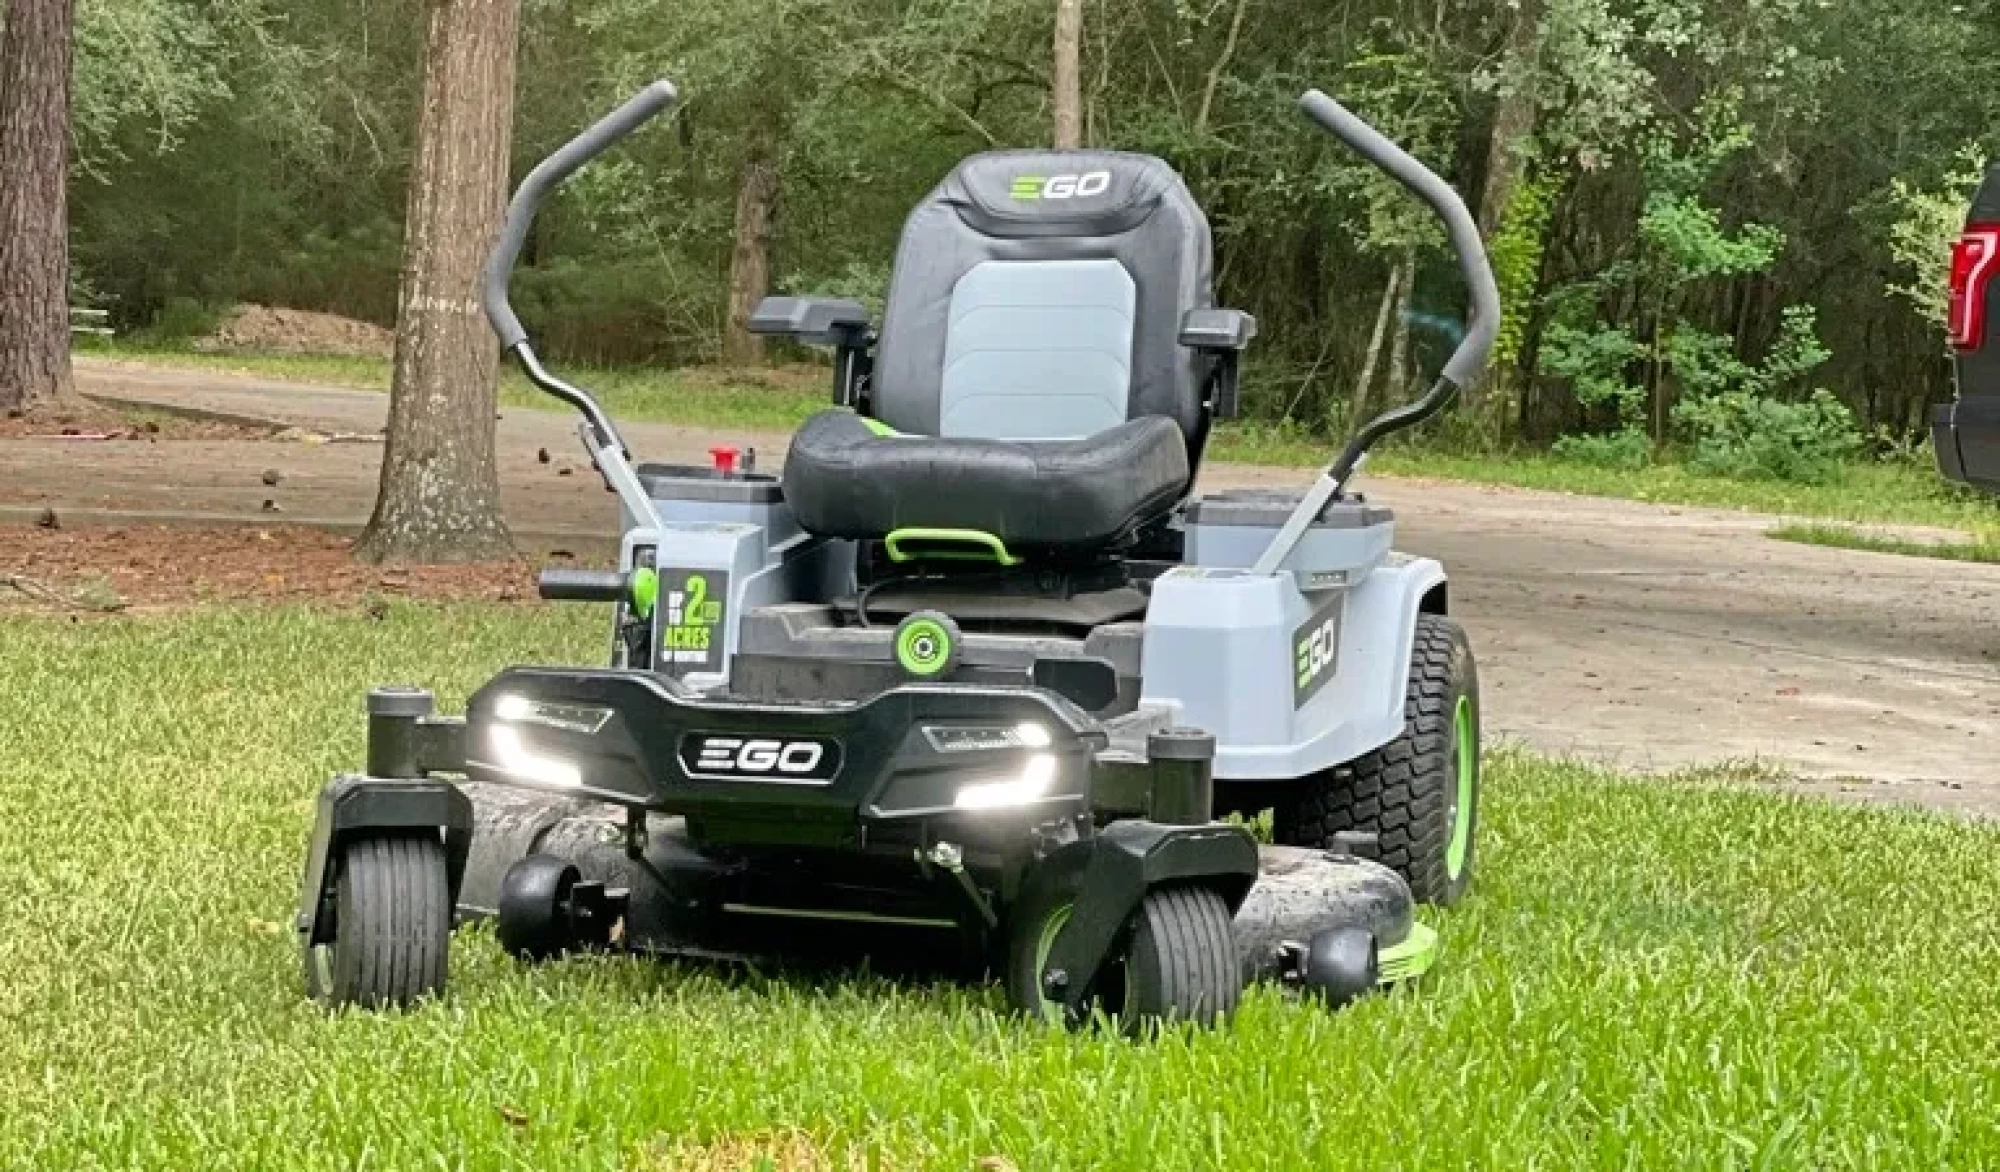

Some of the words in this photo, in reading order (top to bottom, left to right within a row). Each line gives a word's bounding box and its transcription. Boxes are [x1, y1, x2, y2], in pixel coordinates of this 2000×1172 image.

[1010, 171, 1110, 199] EGO
[685, 575, 706, 625] 2
[663, 627, 708, 649] ACRES
[1298, 619, 1333, 688] EGO
[697, 739, 823, 772] EGO
